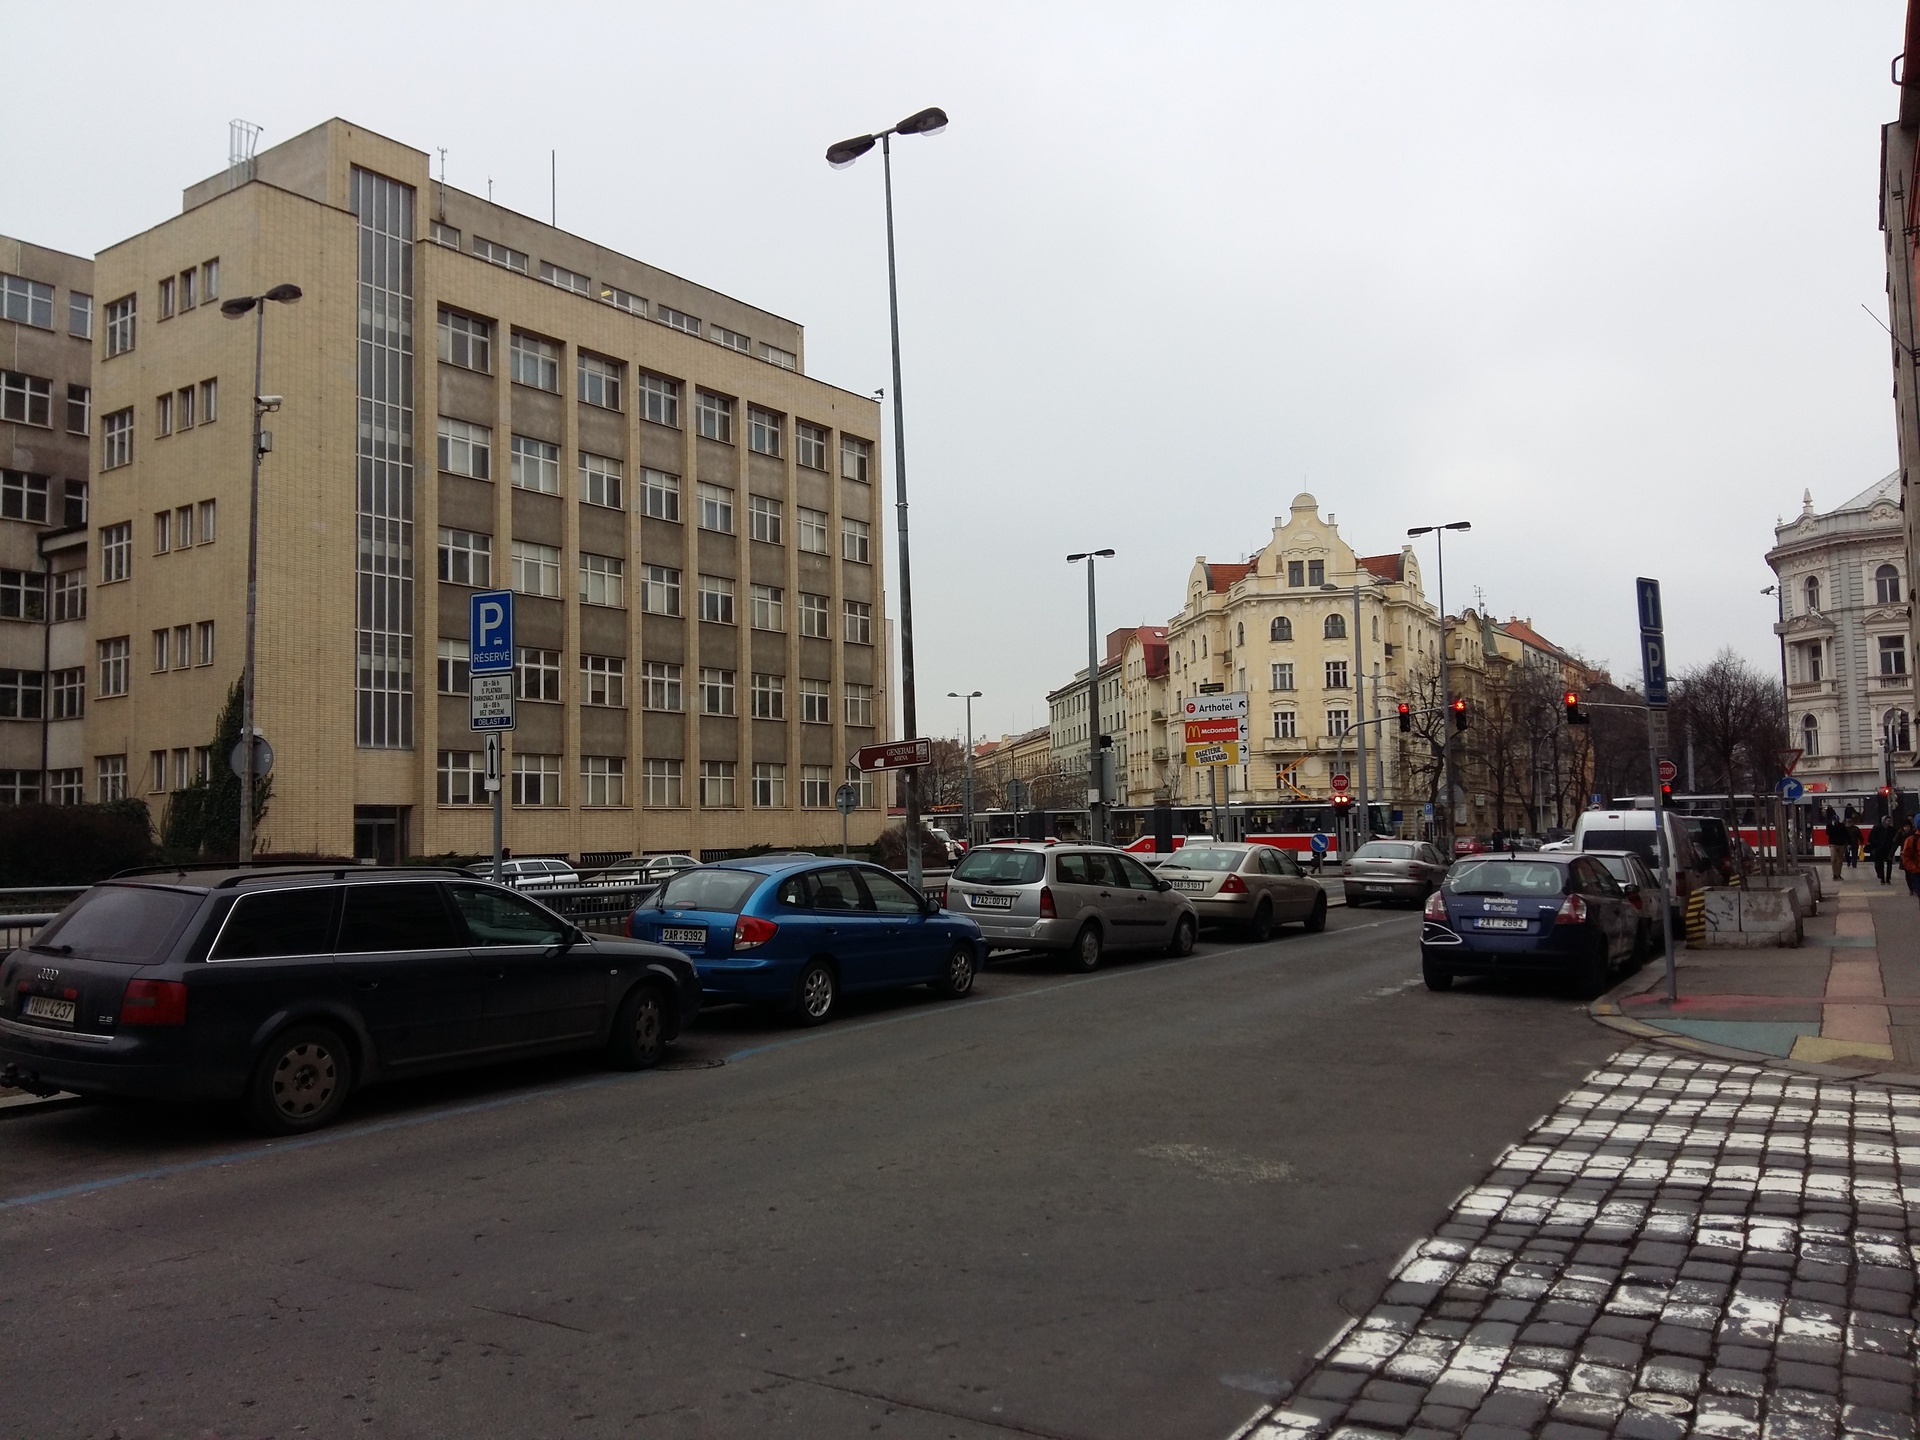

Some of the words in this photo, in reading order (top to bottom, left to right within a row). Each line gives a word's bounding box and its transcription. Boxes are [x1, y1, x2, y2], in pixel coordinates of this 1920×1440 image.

[480, 602, 503, 647] P
[474, 649, 510, 663] RÉSERVÉ
[1647, 642, 1661, 682] P
[1198, 702, 1233, 713] Arthotel
[478, 718, 500, 726] OBLAST
[1201, 727, 1237, 735] McDonald's
[886, 746, 914, 757] GENERALI
[1660, 767, 1674, 775] STOP
[664, 929, 678, 940] 2AR
[684, 930, 703, 942] 9392
[49, 1001, 74, 1019] 4237
